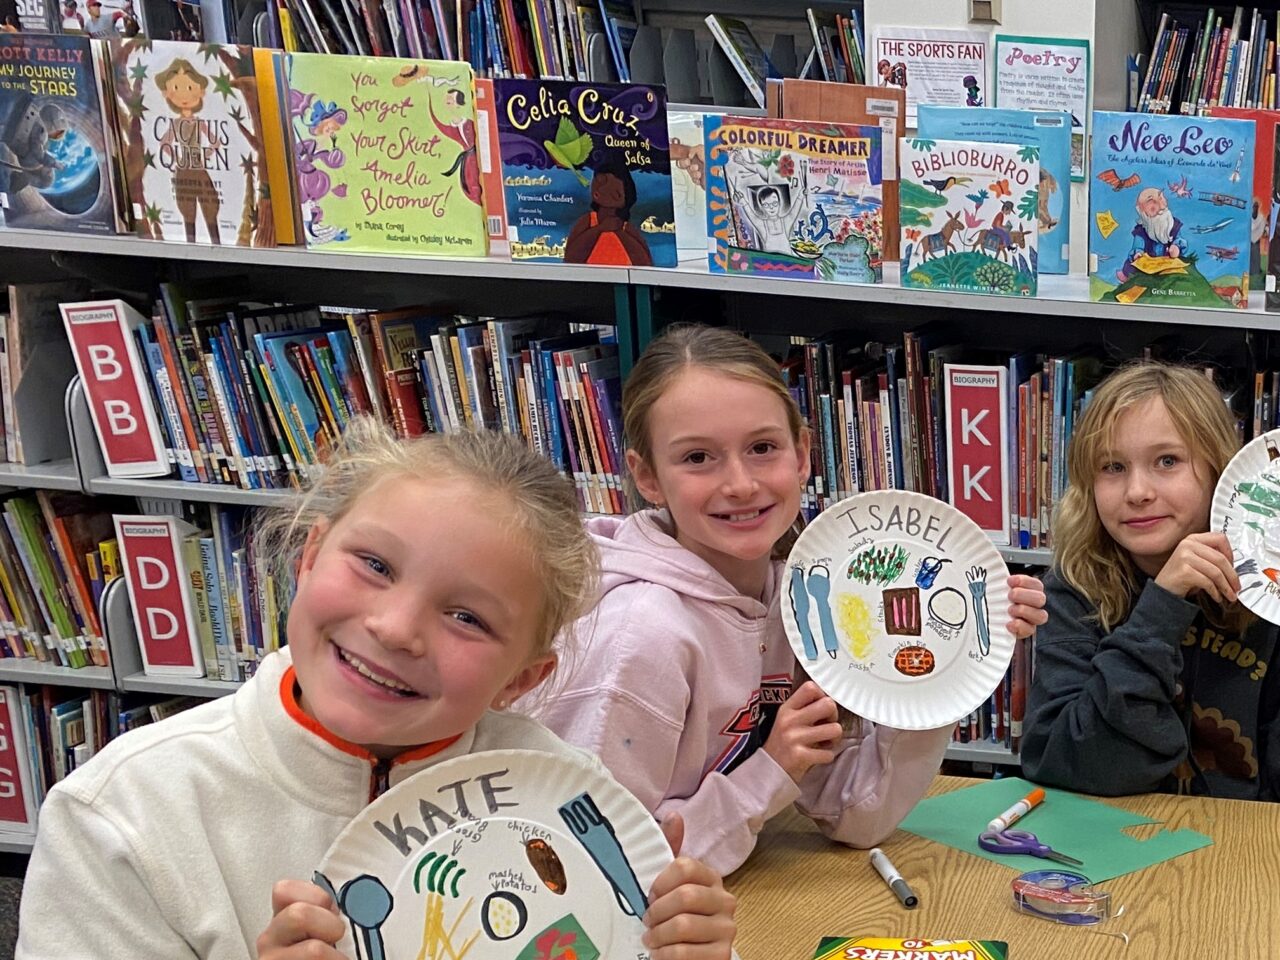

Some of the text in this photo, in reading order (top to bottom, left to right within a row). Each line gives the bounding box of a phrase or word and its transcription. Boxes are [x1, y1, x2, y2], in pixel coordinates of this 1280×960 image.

[36, 48, 84, 63] KELLY
[881, 41, 983, 61] THE SPORTS FAN
[1005, 47, 1081, 74] Poetry
[0, 64, 76, 80] MY JOURNEY
[351, 72, 377, 91] You
[12, 82, 26, 90] THE
[29, 80, 77, 97] STARS
[507, 87, 640, 137] Celia Cruz,
[154, 116, 230, 147] CACTUS
[351, 126, 442, 159] Your Skirt,
[605, 135, 650, 151] Queen of
[718, 129, 869, 157] COLORFUL DREAMER
[1109, 119, 1233, 156] Neo Leo
[159, 144, 230, 172] QUEEN
[625, 151, 651, 166] Salsa
[809, 166, 867, 177] Henri Matisse
[820, 159, 837, 167] Story
[911, 149, 1029, 185] BIBLIOBURRO
[360, 159, 432, 188] Amelia
[361, 186, 453, 217] Bloomer!
[1151, 288, 1197, 298] GENE BARRETTA
[71, 312, 114, 322] BIOGRAPHY
[87, 344, 122, 381] B
[954, 376, 996, 385] BIOGRAPHY
[103, 400, 137, 436] B
[960, 408, 991, 446] K
[882, 425, 891, 450] LYNDON
[846, 421, 857, 484] THOMAS JEFFERSON
[962, 464, 993, 502] K
[836, 504, 953, 553] ISABEL
[135, 556, 169, 590] D
[203, 571, 216, 593] Solo
[146, 607, 179, 640] D
[373, 768, 520, 857] KATE
[507, 821, 552, 841] chicken
[902, 939, 924, 949] 10
